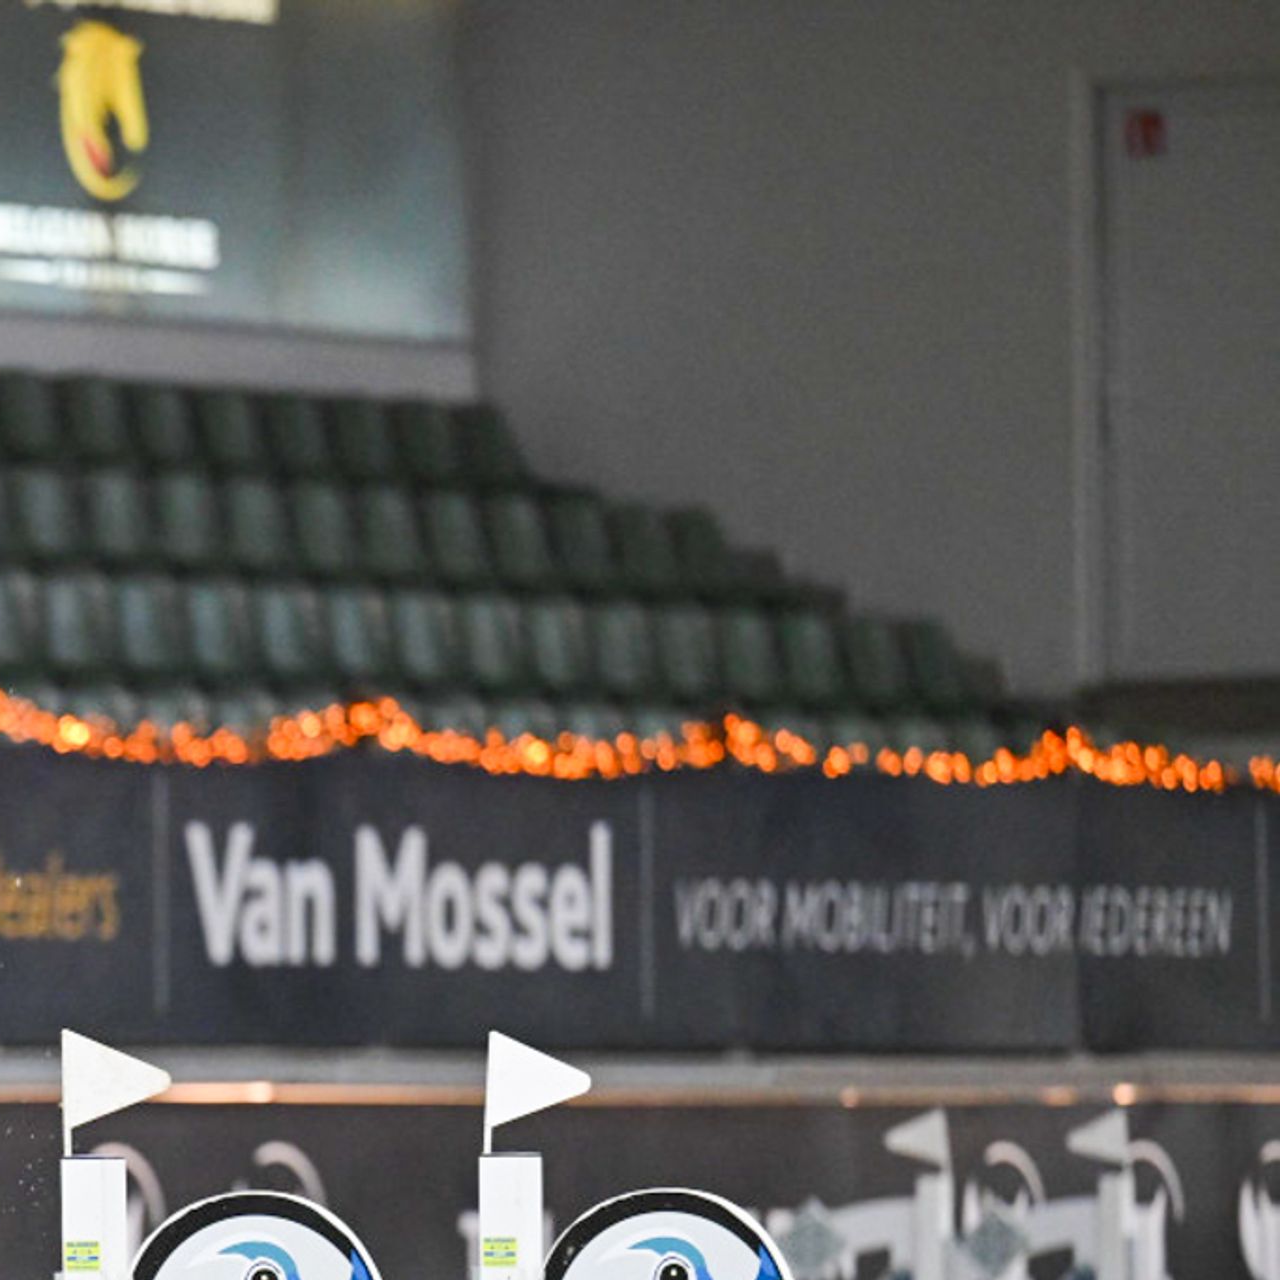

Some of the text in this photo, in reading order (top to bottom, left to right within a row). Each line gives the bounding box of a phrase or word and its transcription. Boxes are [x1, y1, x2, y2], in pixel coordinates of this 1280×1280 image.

[185, 821, 613, 970] Van Mossel
[675, 878, 777, 951] VOOR
[982, 884, 1074, 957] VOOR
[1080, 885, 1233, 957] IEDEREEN
